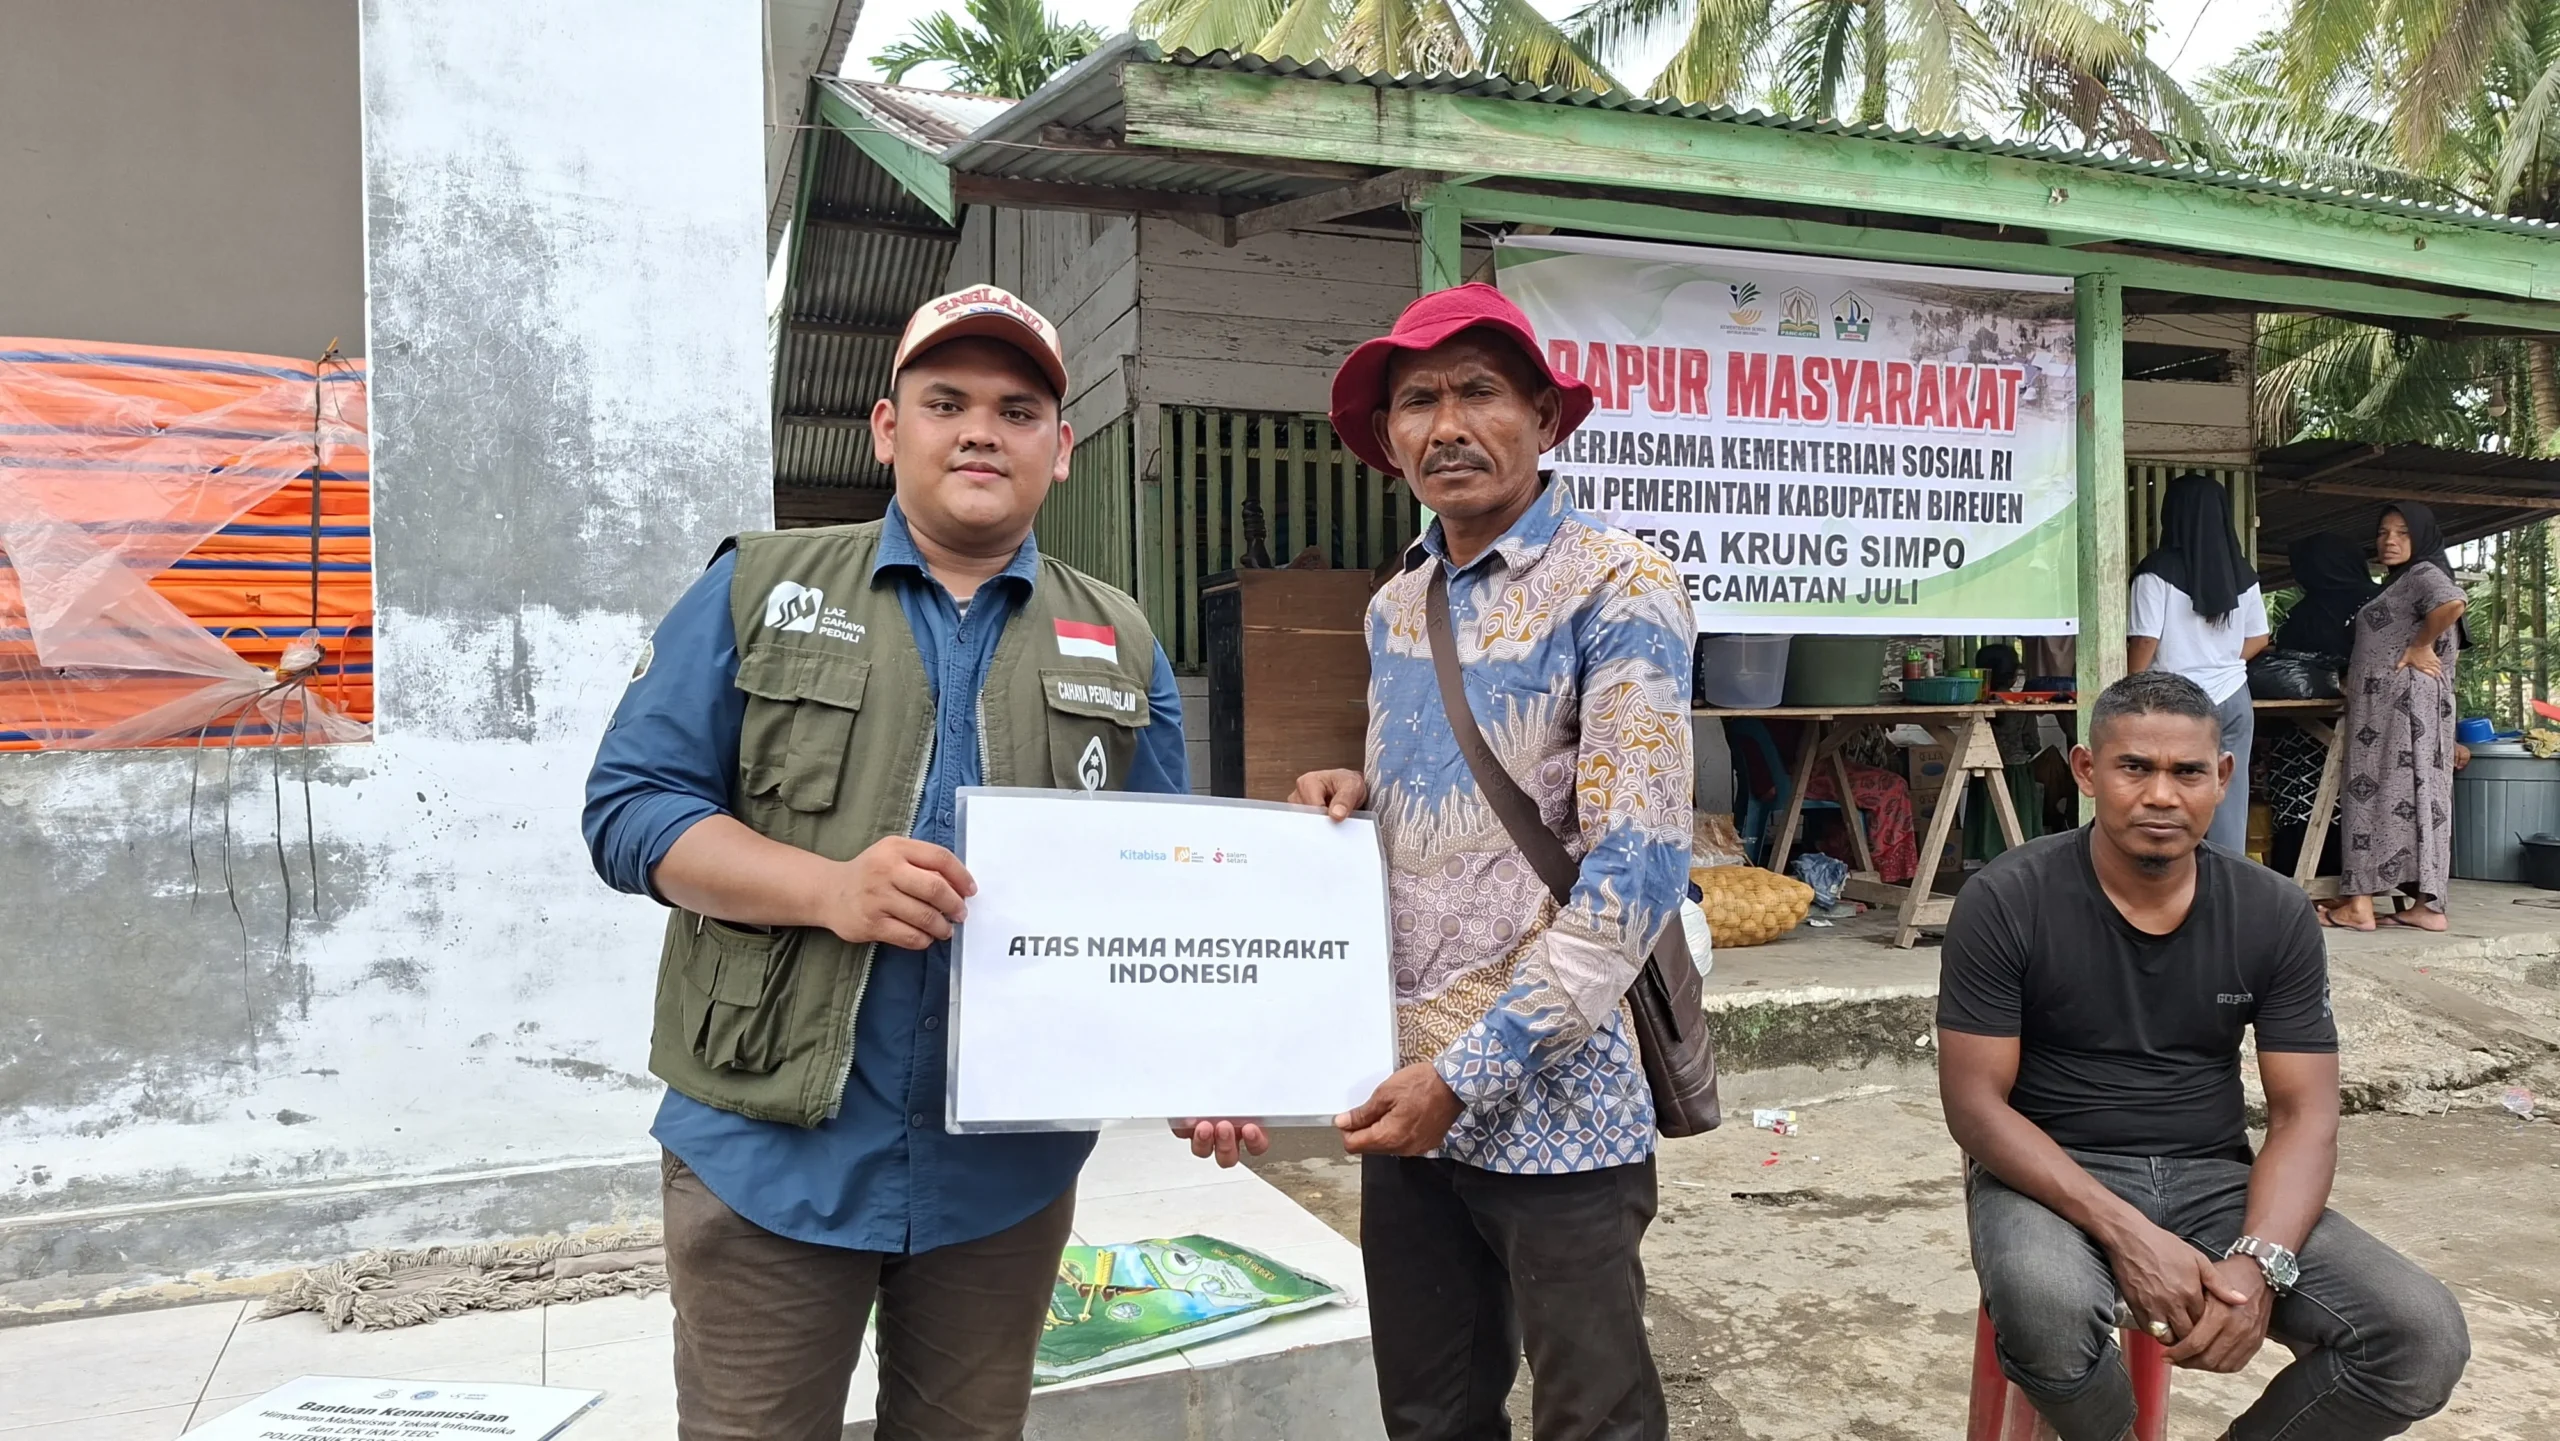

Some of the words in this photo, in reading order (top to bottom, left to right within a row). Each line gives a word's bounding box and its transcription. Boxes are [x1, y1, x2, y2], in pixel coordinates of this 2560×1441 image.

[934, 288, 1043, 333] ENGLAND
[1548, 339, 1709, 416] DAPUR
[1727, 352, 2022, 430] MASYARAKAT
[1555, 430, 1715, 468] KERJASAMA
[1721, 436, 1895, 475] KEMENTERIAN
[1902, 445, 1984, 481] SOSIAL
[1991, 448, 2012, 481] RI
[1562, 475, 1596, 510] AN
[1603, 477, 1770, 516] PEMERINTAH
[1778, 485, 1920, 522] KABUPATEN
[1927, 490, 2023, 525] BIREUEN
[1720, 532, 1848, 566] KRUNG
[1860, 535, 1965, 570] SIMPO
[1683, 573, 1847, 605] ECAMATAN
[1856, 578, 1919, 605] JULI
[824, 607, 847, 617] LAZ
[819, 627, 860, 643] PEDULI
[822, 617, 866, 634] CAHAYA
[1058, 681, 1089, 703] CAHAYA
[1120, 849, 1167, 861] Kitabisa
[1009, 936, 1079, 957] ATAS
[1088, 937, 1166, 957] NAMA
[1175, 938, 1349, 960] MASYARAKAT
[1109, 963, 1258, 984] INDONESIA
[259, 1411, 324, 1422] Himpunan
[324, 1417, 397, 1426] Mahasiswa
[399, 1420, 441, 1428] Teknik
[441, 1422, 516, 1435] Informatika
[297, 1402, 377, 1415] Bantuan
[378, 1408, 509, 1422] Kemanusiaan
[307, 1425, 334, 1433] dan
[335, 1427, 366, 1436] LDK
[365, 1428, 400, 1437] IKMI
[400, 1430, 440, 1438] TEDC
